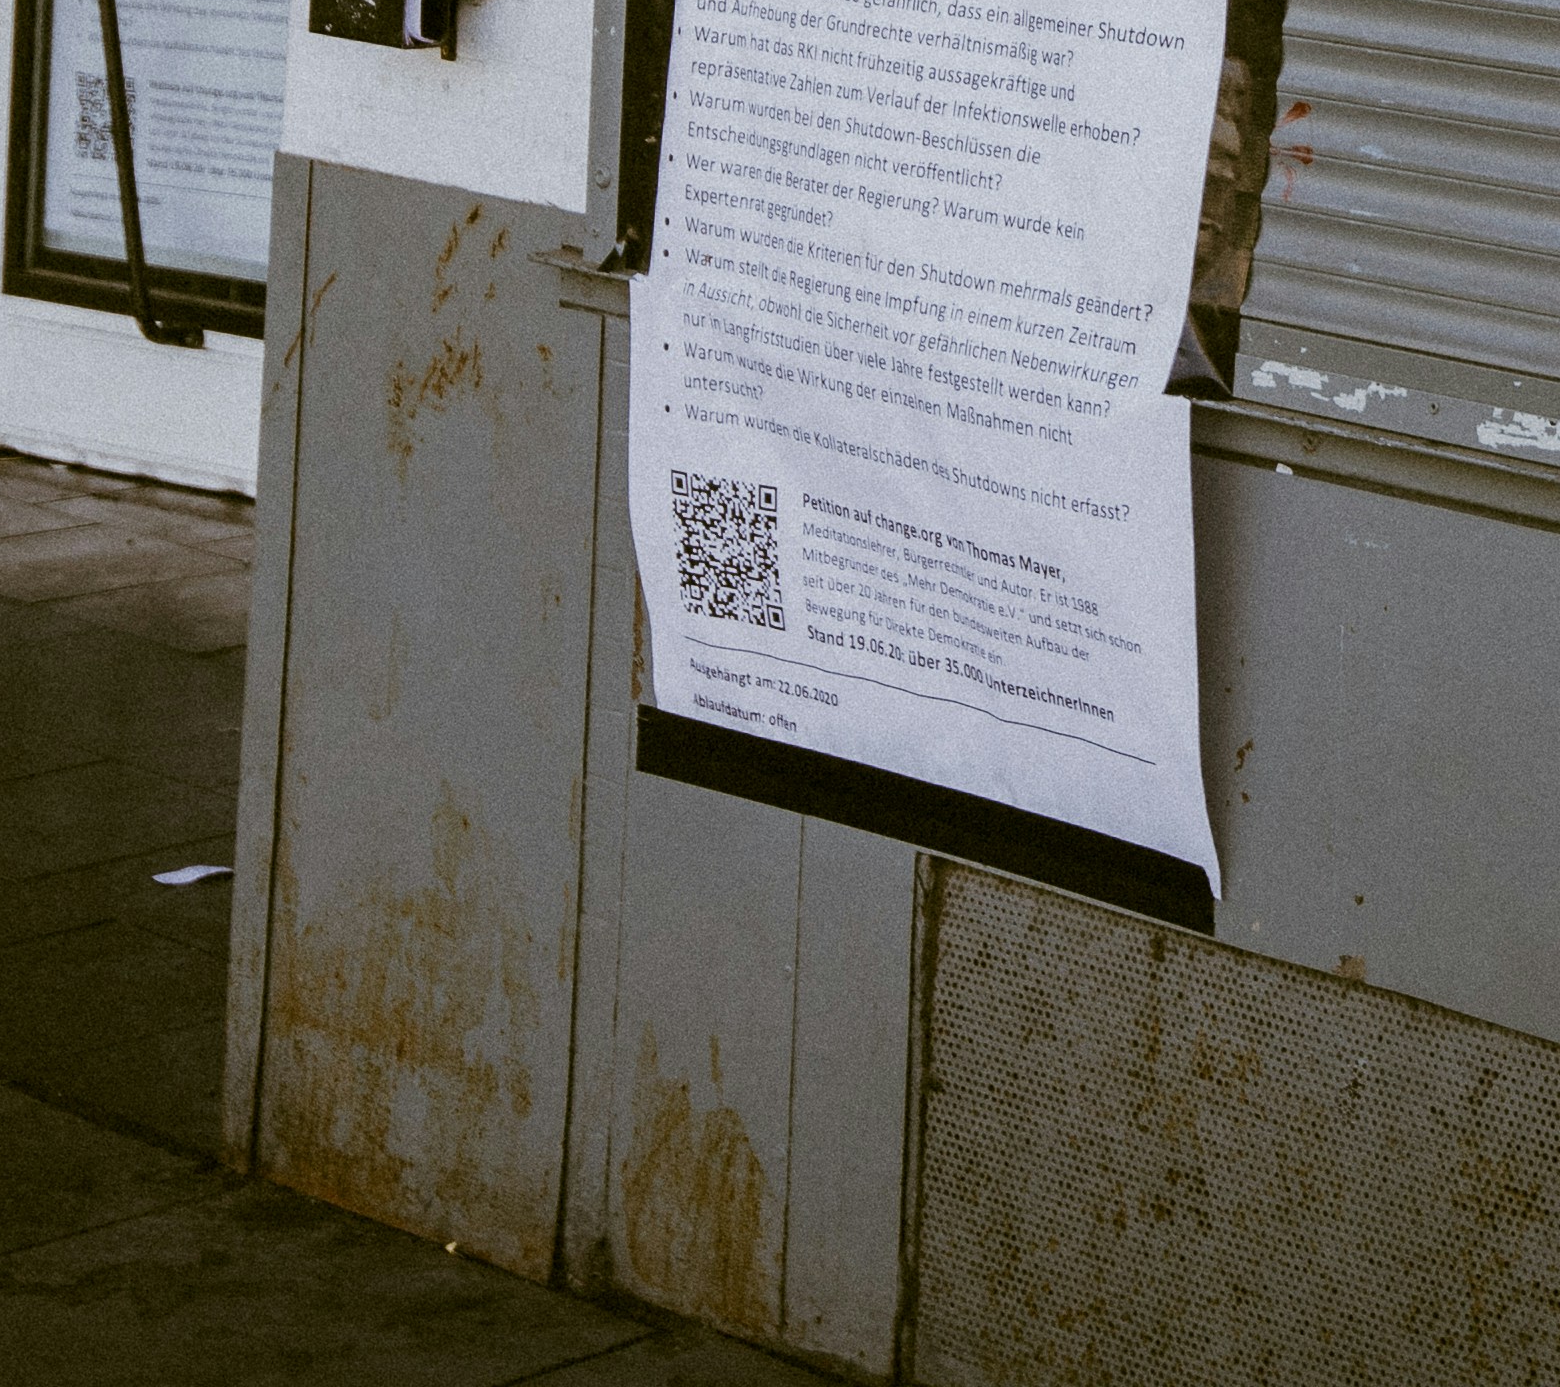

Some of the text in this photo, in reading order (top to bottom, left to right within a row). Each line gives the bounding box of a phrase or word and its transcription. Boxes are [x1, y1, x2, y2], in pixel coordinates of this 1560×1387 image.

[802, 492, 1068, 585] Petition auf change.org von Thomas Mayer,
[806, 624, 845, 648] Stand
[908, 648, 941, 671] über
[944, 656, 984, 685] 35.000
[984, 671, 1116, 723] UnterzeichnerInnen
